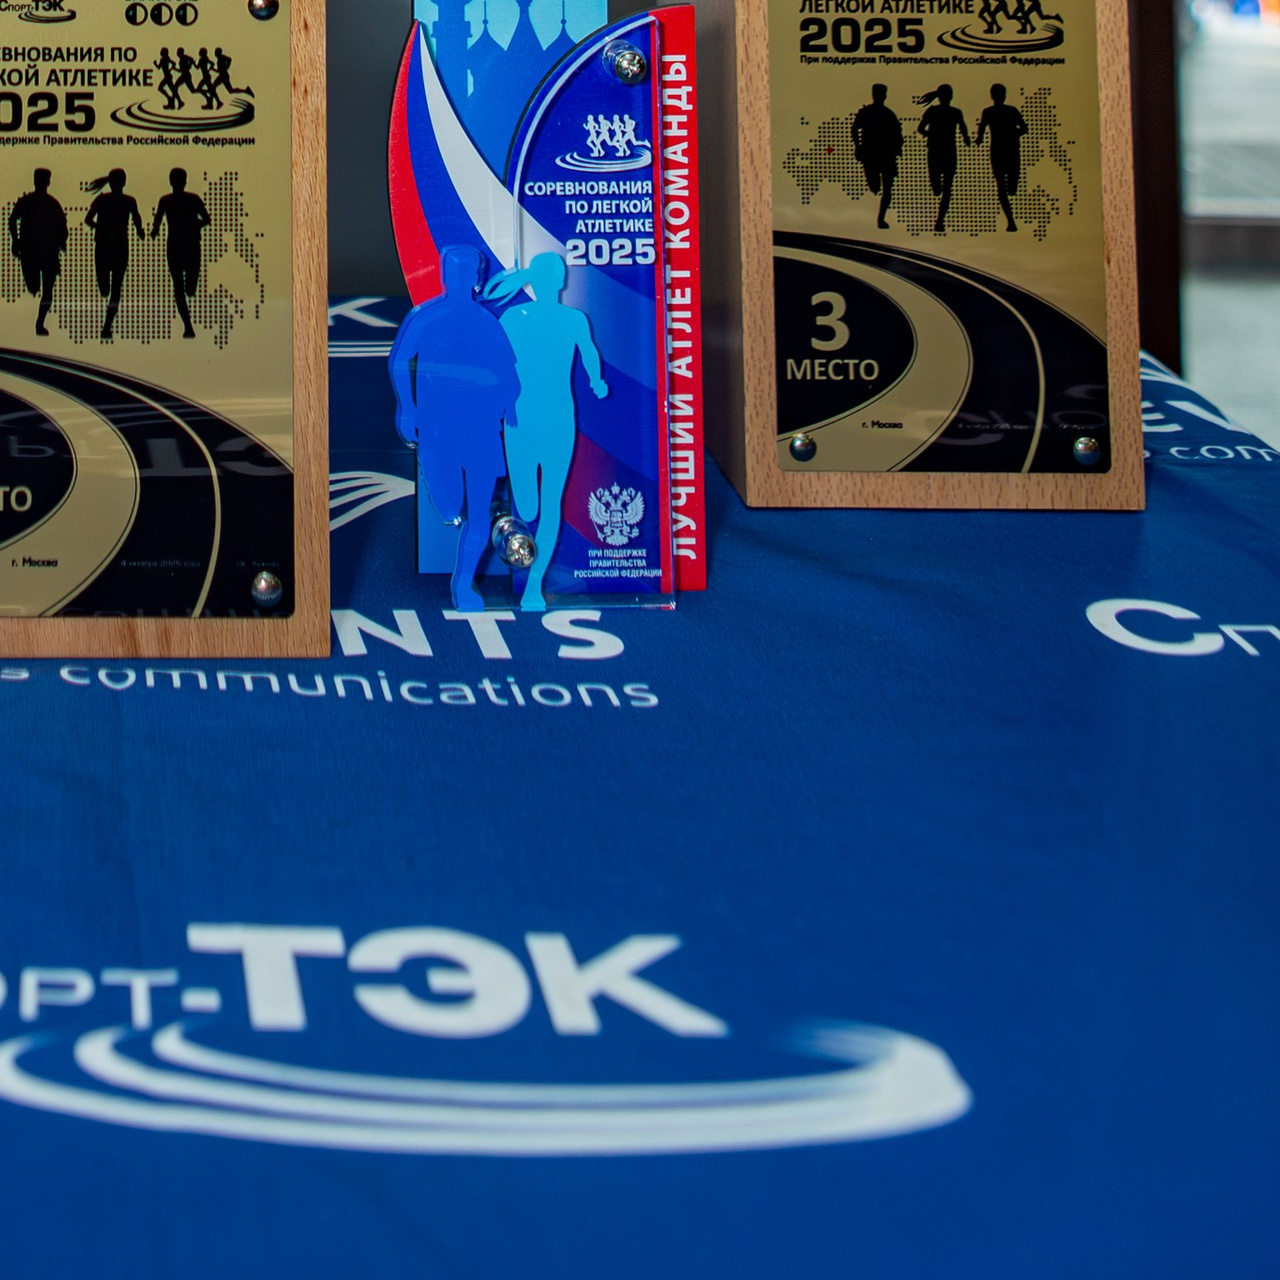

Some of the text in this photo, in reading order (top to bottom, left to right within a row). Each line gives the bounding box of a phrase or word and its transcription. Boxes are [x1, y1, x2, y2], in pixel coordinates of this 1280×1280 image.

[800, 18, 926, 53] 2025
[110, 47, 138, 63] ПО
[800, 55, 1065, 66] При поддержке Правительства Российской Федерации
[46, 69, 154, 87] АТЛЕТИКЕ
[43, 135, 124, 146] Правительства
[126, 134, 189, 146] Российской
[192, 135, 256, 147] Федерации
[524, 180, 653, 197] СОРЕВНОВАНИЯ
[565, 197, 653, 215] ПО ЛЕГКОЙ
[575, 217, 654, 234] АТЛЕТИКЕ
[565, 237, 656, 266] 2025
[663, 53, 697, 560] ЛУЧШИЙ АТЛЕТ КОМАНДЫ
[810, 291, 850, 351] 3
[786, 358, 880, 381] МЕСТО
[588, 548, 647, 558] ПРИ ПОДДЕРЖКЕ
[22, 557, 58, 569] Москва
[589, 558, 646, 568] ПРАВИТЕЛЬСТВА
[574, 567, 663, 579] РОССИЙСКОЙ ФЕДЕРАЦИИ
[58, 666, 660, 708] communications
